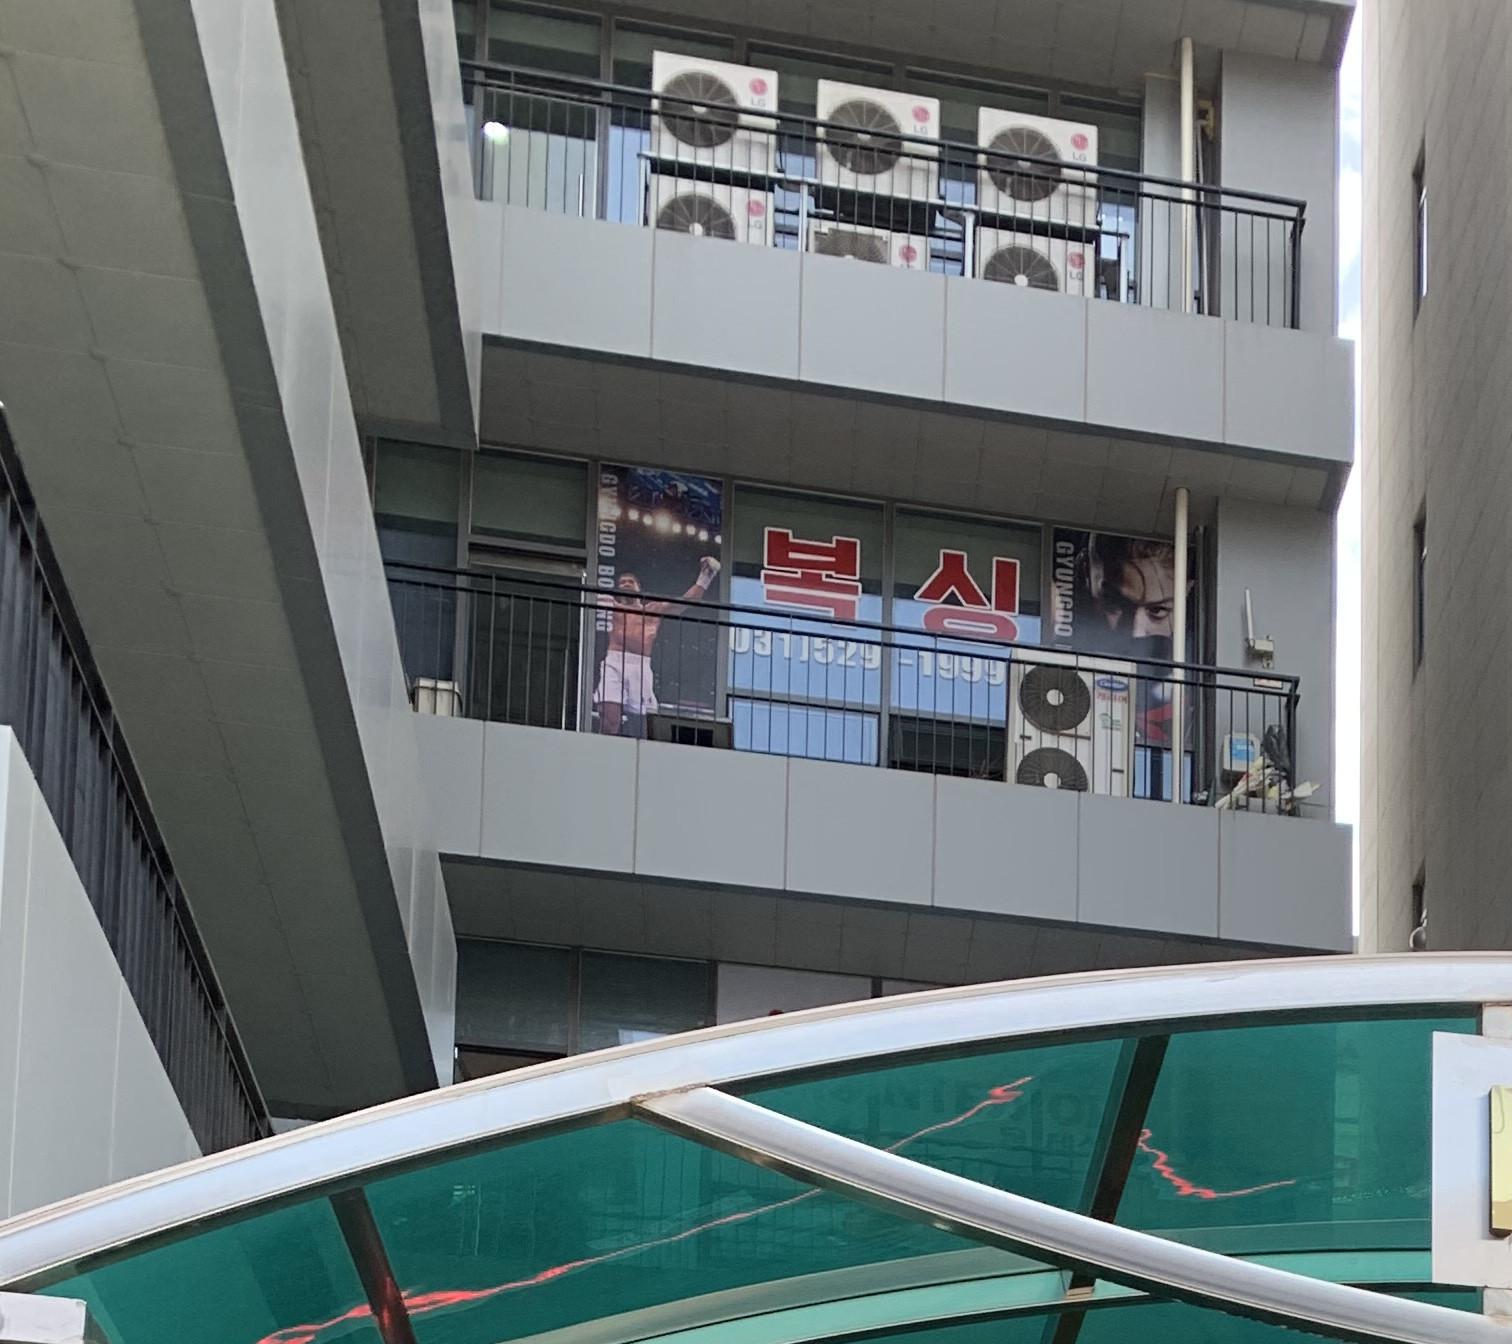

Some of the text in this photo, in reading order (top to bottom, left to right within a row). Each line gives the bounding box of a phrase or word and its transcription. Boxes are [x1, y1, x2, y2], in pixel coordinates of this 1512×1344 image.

[750, 98, 766, 108] LG
[913, 124, 928, 135] LG
[1072, 152, 1087, 162] LG
[760, 526, 1020, 647] 복싱
[1054, 540, 1075, 638] GYUNGDO
